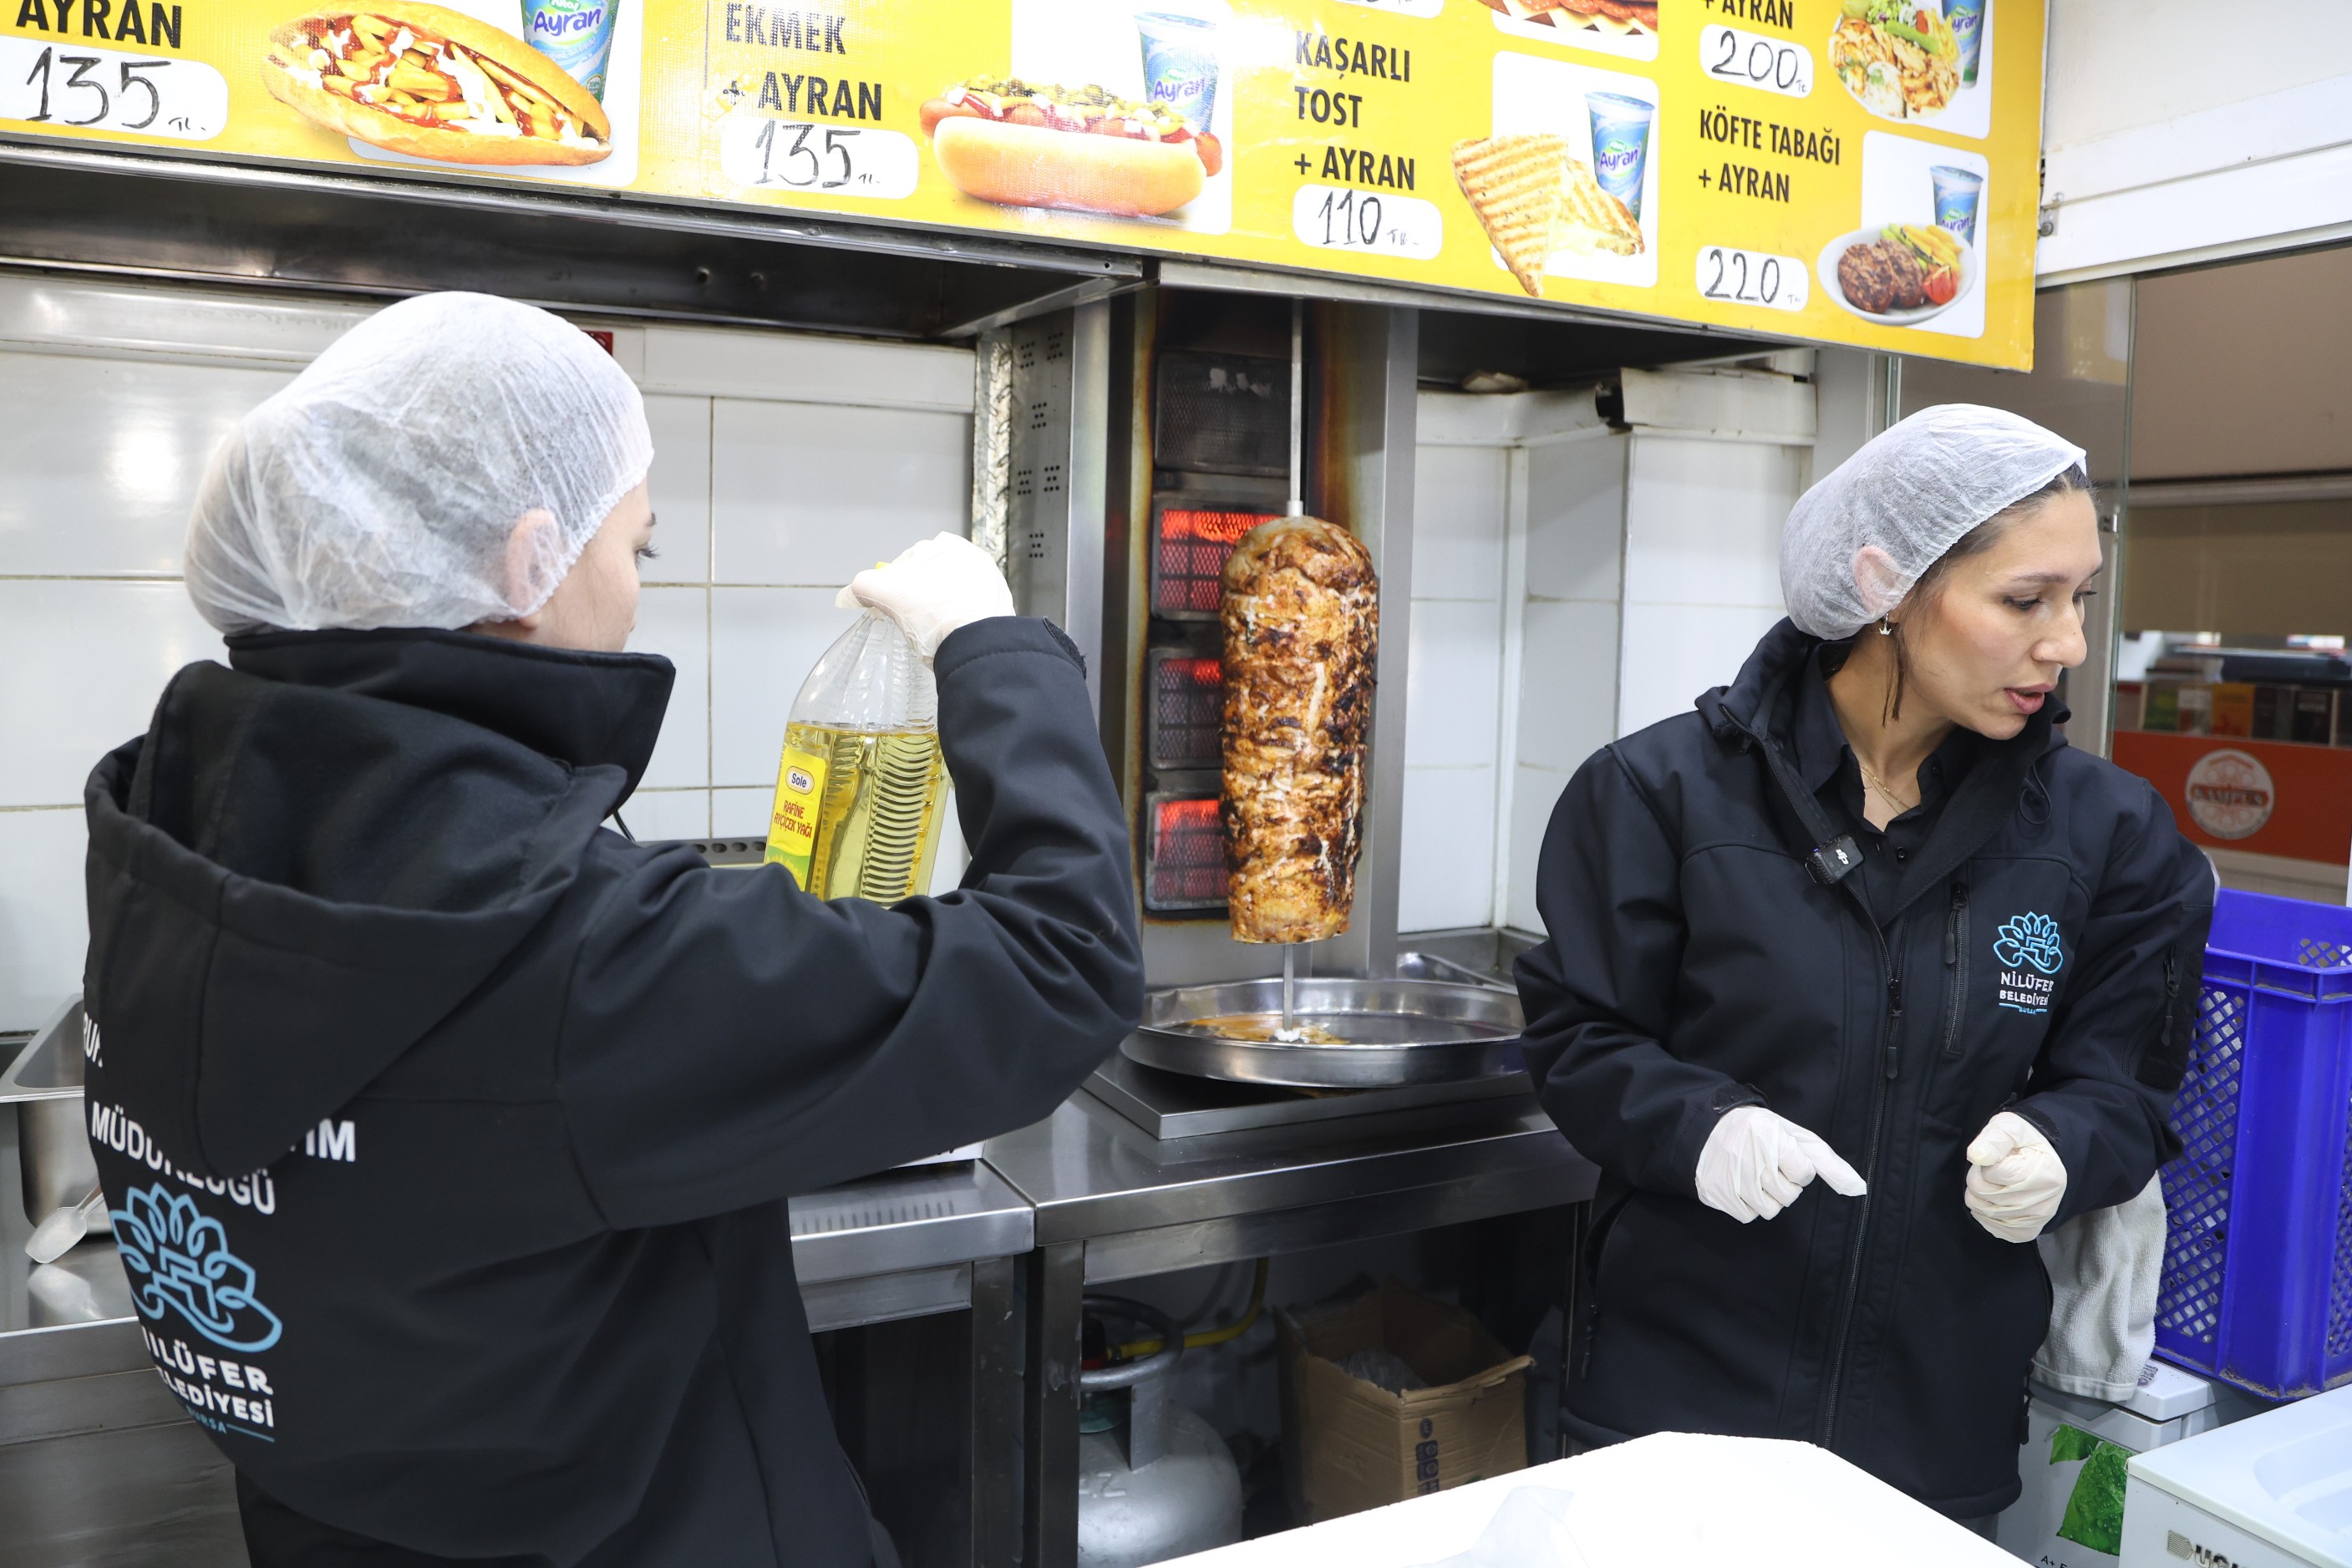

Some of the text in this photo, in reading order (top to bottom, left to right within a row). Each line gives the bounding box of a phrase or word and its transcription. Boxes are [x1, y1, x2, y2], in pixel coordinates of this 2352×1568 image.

[16, 0, 181, 49] AYRAN
[534, 8, 602, 37] Ayran
[726, 3, 846, 54] EKMEK
[1722, 0, 1792, 30] AYRAN
[1952, 15, 1978, 33] yran
[1296, 30, 1410, 83] KAŞARLI
[1711, 30, 1798, 89] 200
[26, 46, 171, 129] 135
[758, 71, 881, 121] AYRAN
[1294, 85, 1363, 129] TOST
[754, 119, 861, 189] 135
[1699, 104, 1841, 166] KÖFTE TABAĞI
[1321, 145, 1415, 191] AYRAN
[1599, 149, 1638, 170] Ayran
[1719, 162, 1790, 204] AYRAN
[1318, 189, 1382, 246] 110
[1704, 249, 1781, 304] 220
[791, 773, 807, 788] Sole
[783, 799, 805, 820] RAFİNE
[1999, 989, 2050, 1006] BELEDİYESİ
[2000, 971, 2055, 992] NİLÜFER
